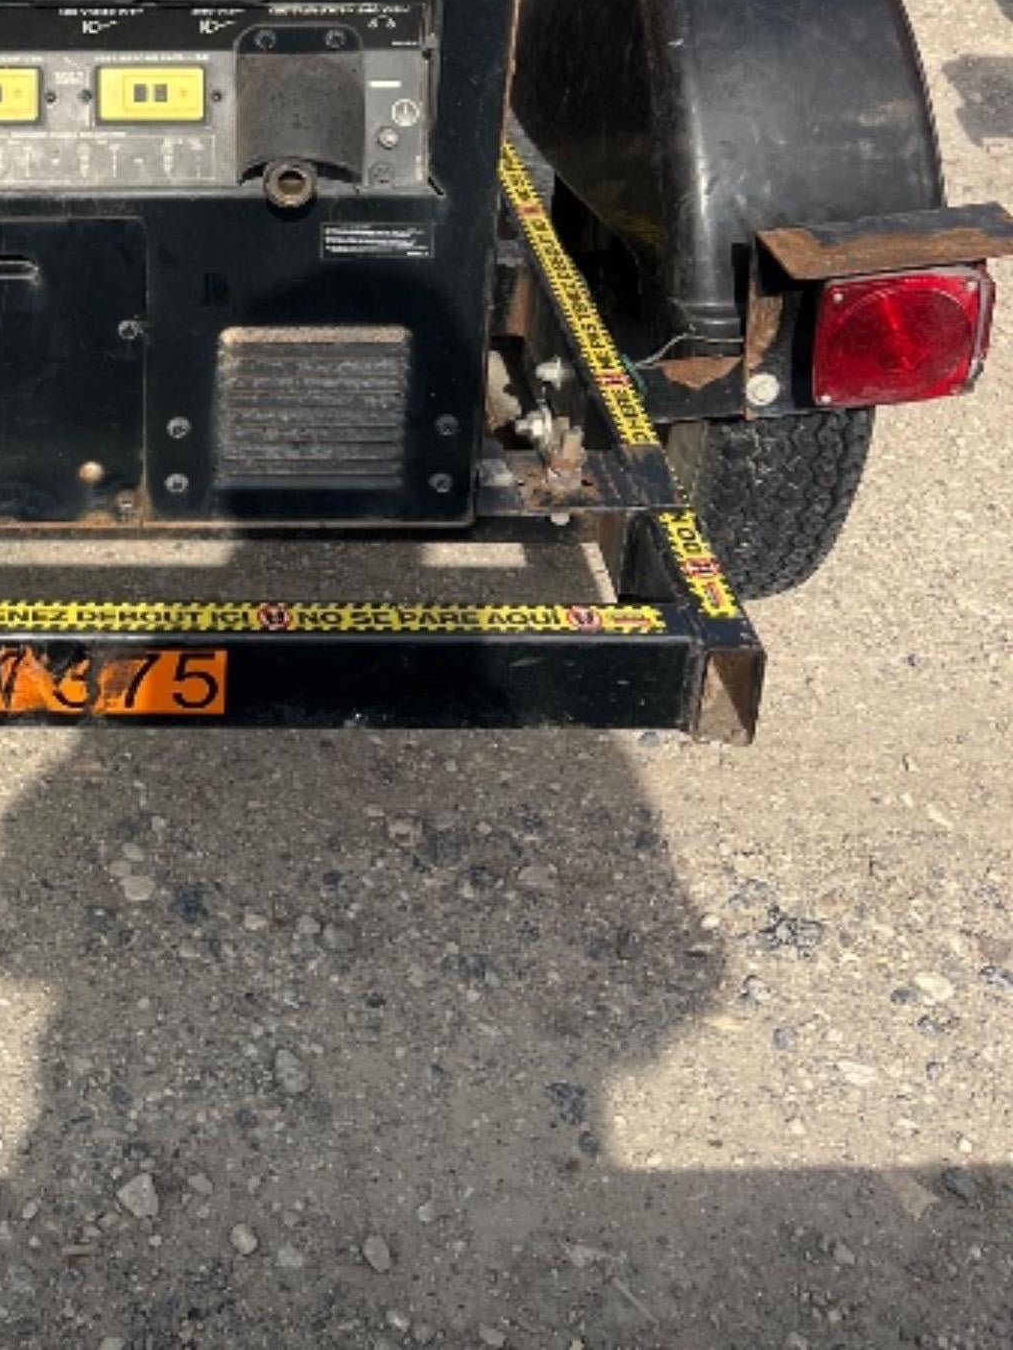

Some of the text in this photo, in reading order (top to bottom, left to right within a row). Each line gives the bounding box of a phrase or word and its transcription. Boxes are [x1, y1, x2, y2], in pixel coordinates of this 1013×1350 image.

[297, 610, 342, 624] NO
[350, 611, 389, 624] SE
[399, 611, 479, 624] PARE
